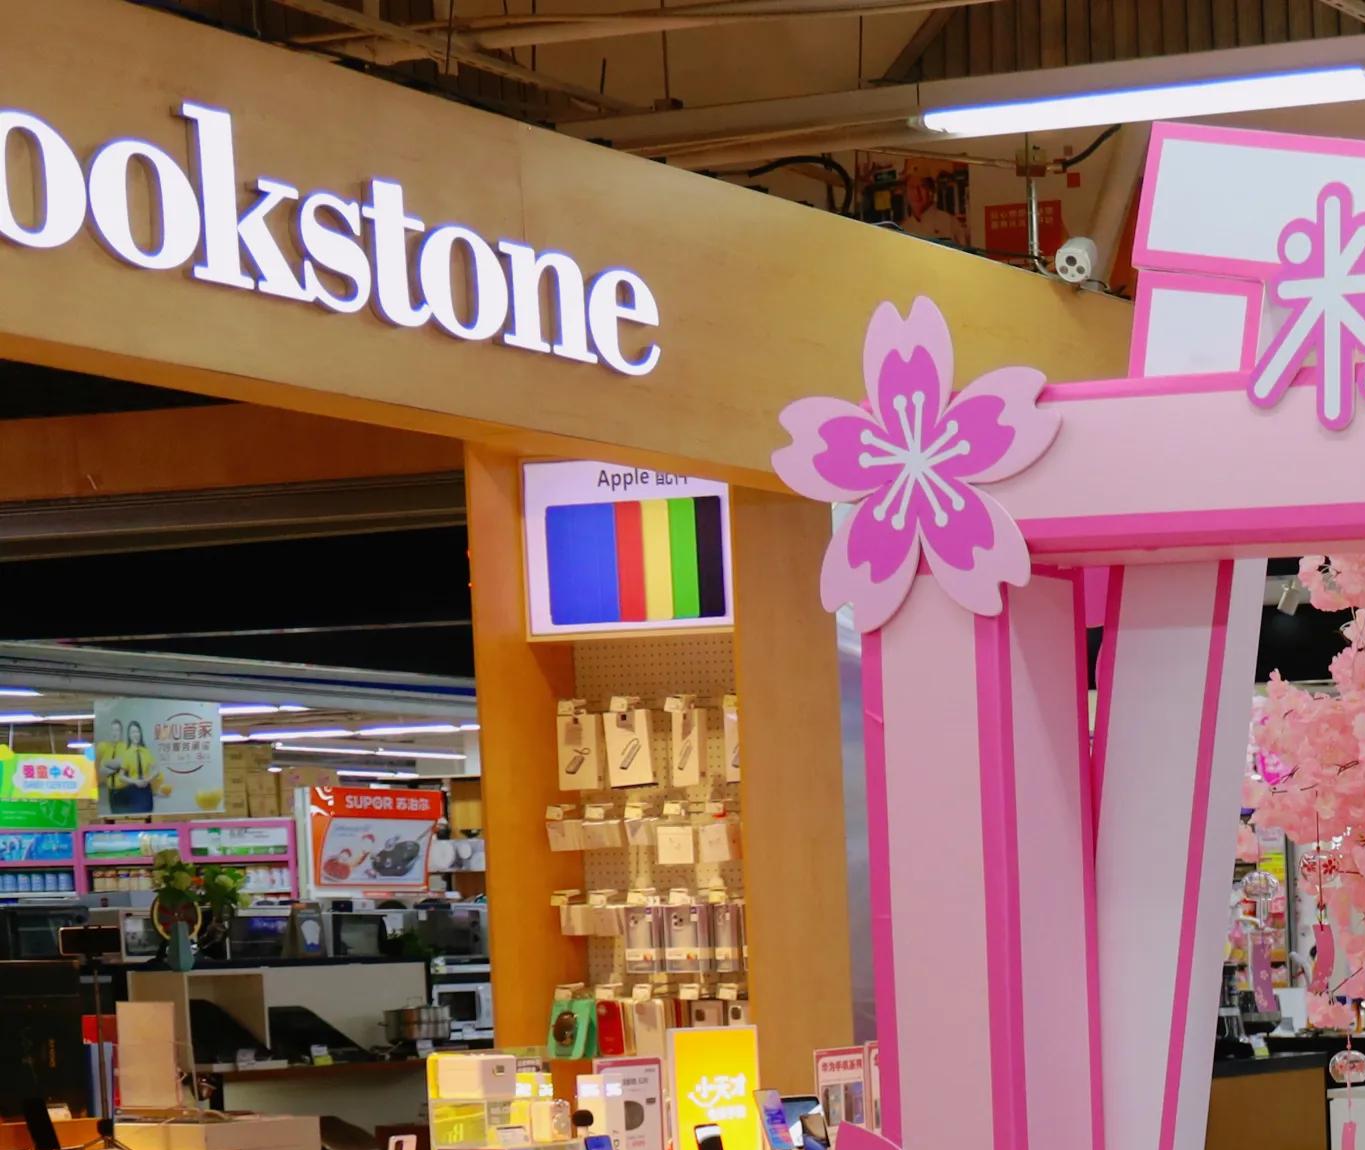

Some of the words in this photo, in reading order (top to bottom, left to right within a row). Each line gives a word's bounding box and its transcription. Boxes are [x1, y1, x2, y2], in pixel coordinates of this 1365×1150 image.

[0, 103, 661, 376] ookstone
[597, 468, 649, 491] Apple
[344, 795, 393, 810] SUPOR
